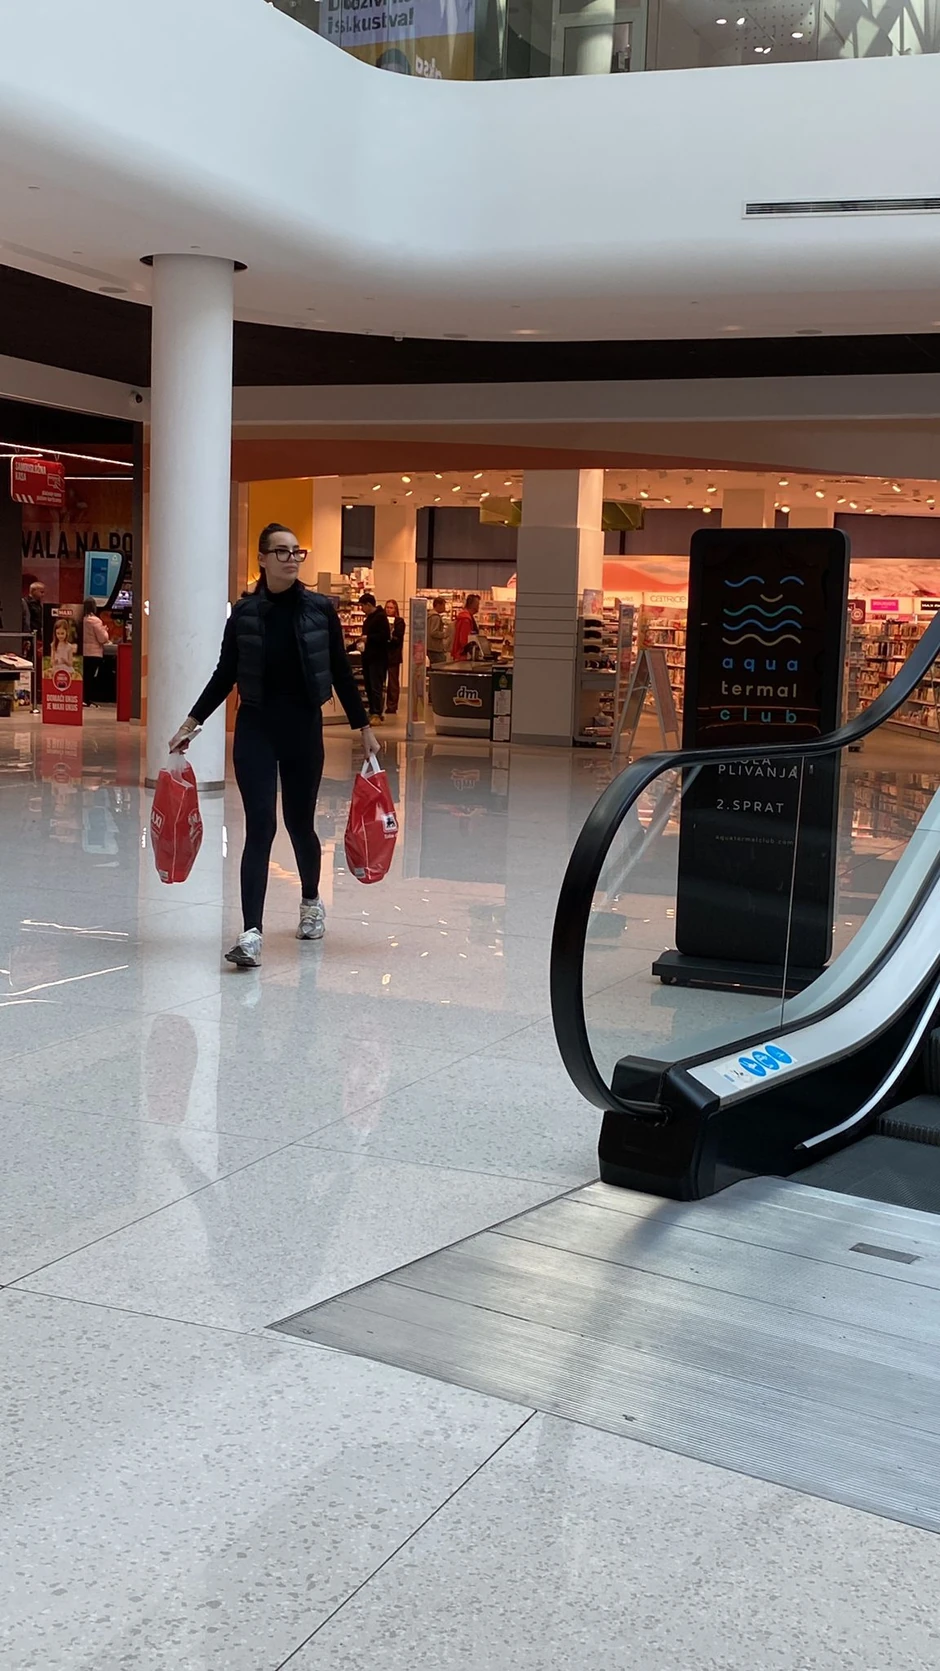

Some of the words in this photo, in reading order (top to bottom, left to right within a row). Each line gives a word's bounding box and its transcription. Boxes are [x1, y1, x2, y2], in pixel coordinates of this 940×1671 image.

[722, 657, 798, 672] aqua
[458, 687, 478, 699] dm
[721, 681, 797, 698] termal
[720, 707, 797, 723] club
[718, 764, 798, 779] PLIVANJA
